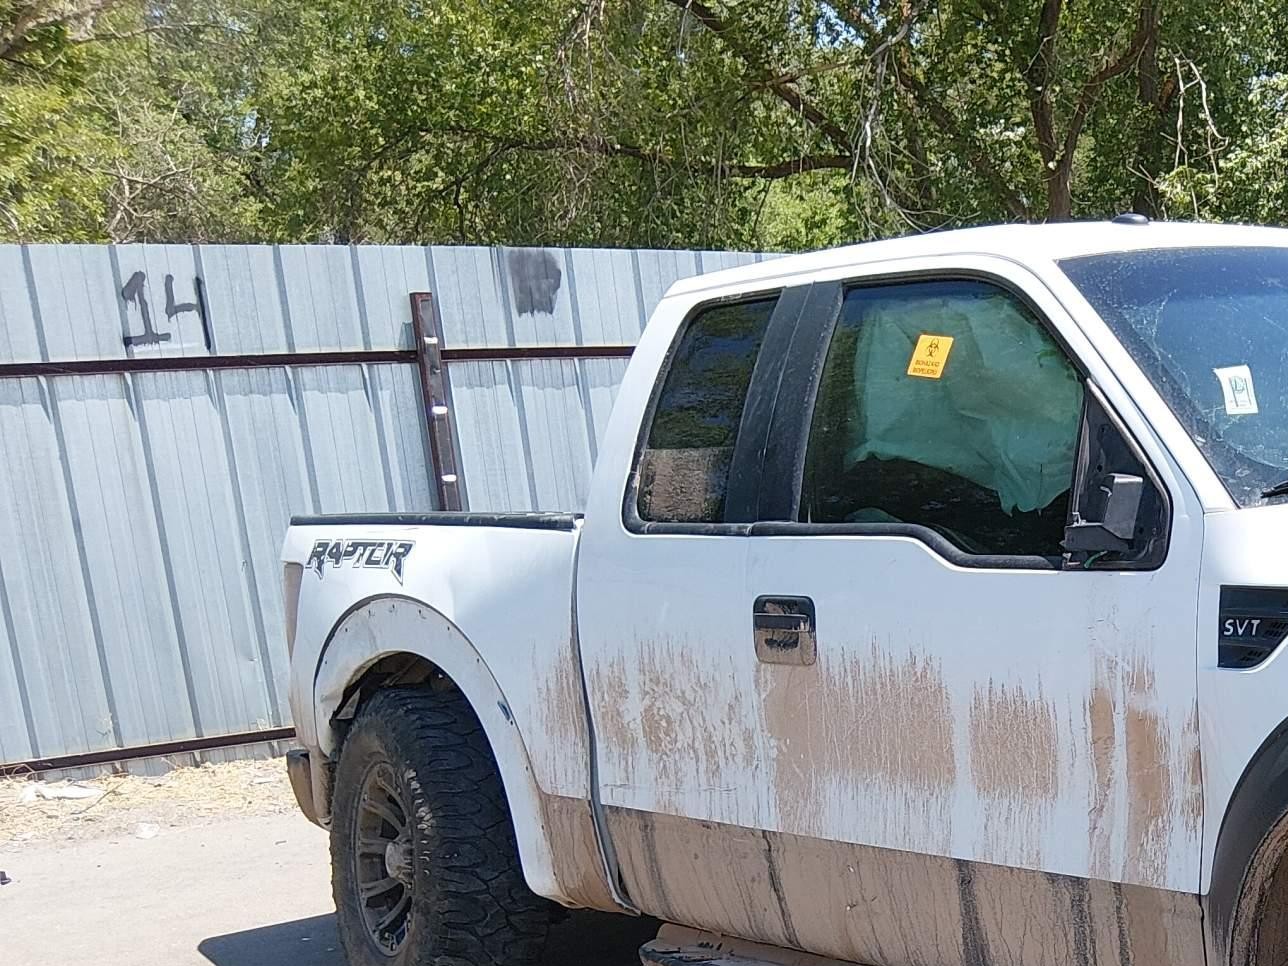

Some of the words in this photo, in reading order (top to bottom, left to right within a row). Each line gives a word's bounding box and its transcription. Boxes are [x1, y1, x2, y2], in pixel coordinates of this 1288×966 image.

[121, 270, 212, 350] 14
[305, 538, 416, 587] RAPTOR
[1223, 618, 1261, 636] SVT
